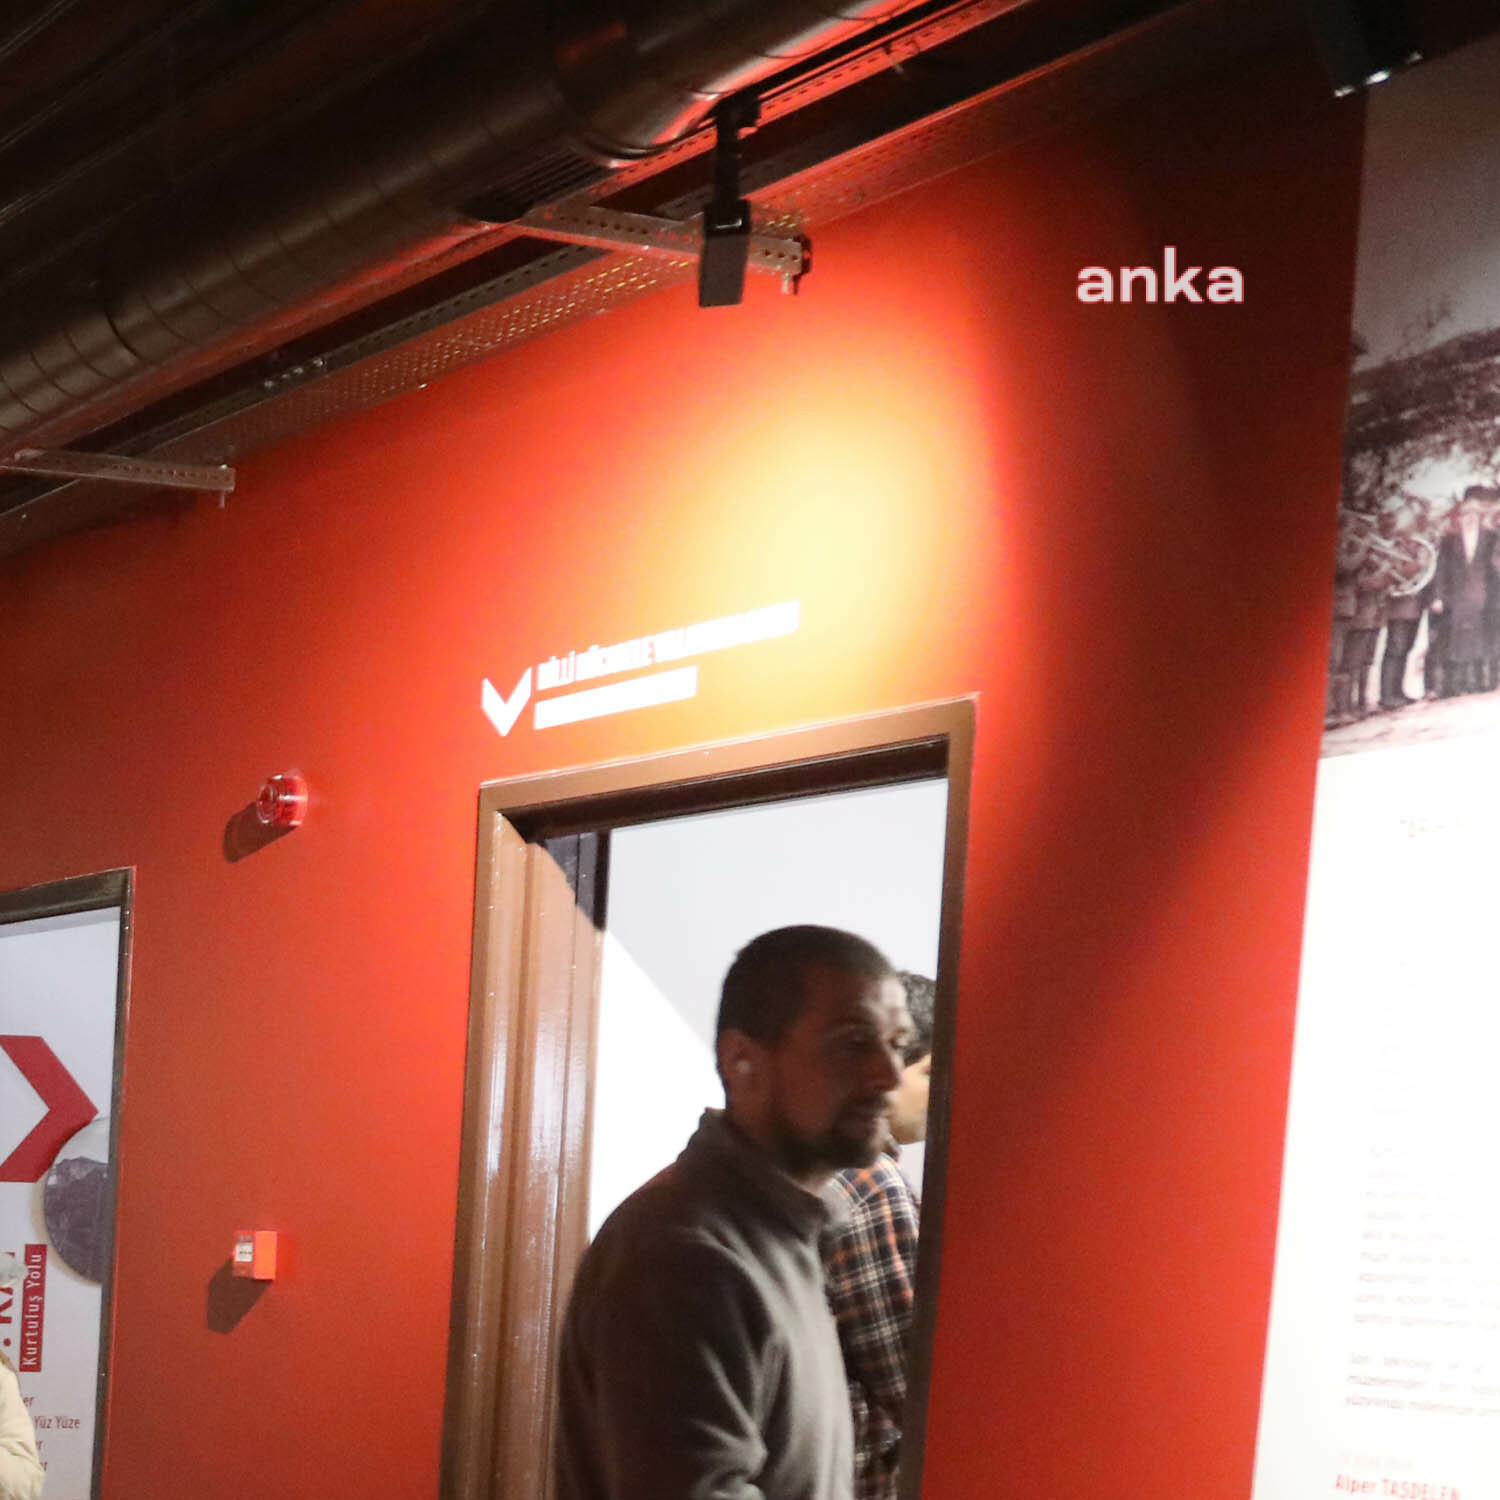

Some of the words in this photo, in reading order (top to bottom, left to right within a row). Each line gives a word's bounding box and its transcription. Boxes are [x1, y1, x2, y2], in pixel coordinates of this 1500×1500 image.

[26, 1253, 42, 1289] Yolu
[23, 1296, 43, 1366] Kurtuluş
[34, 1415, 52, 1429] Yüz
[54, 1415, 81, 1429] Yüze
[1334, 1473, 1377, 1497] Alper
